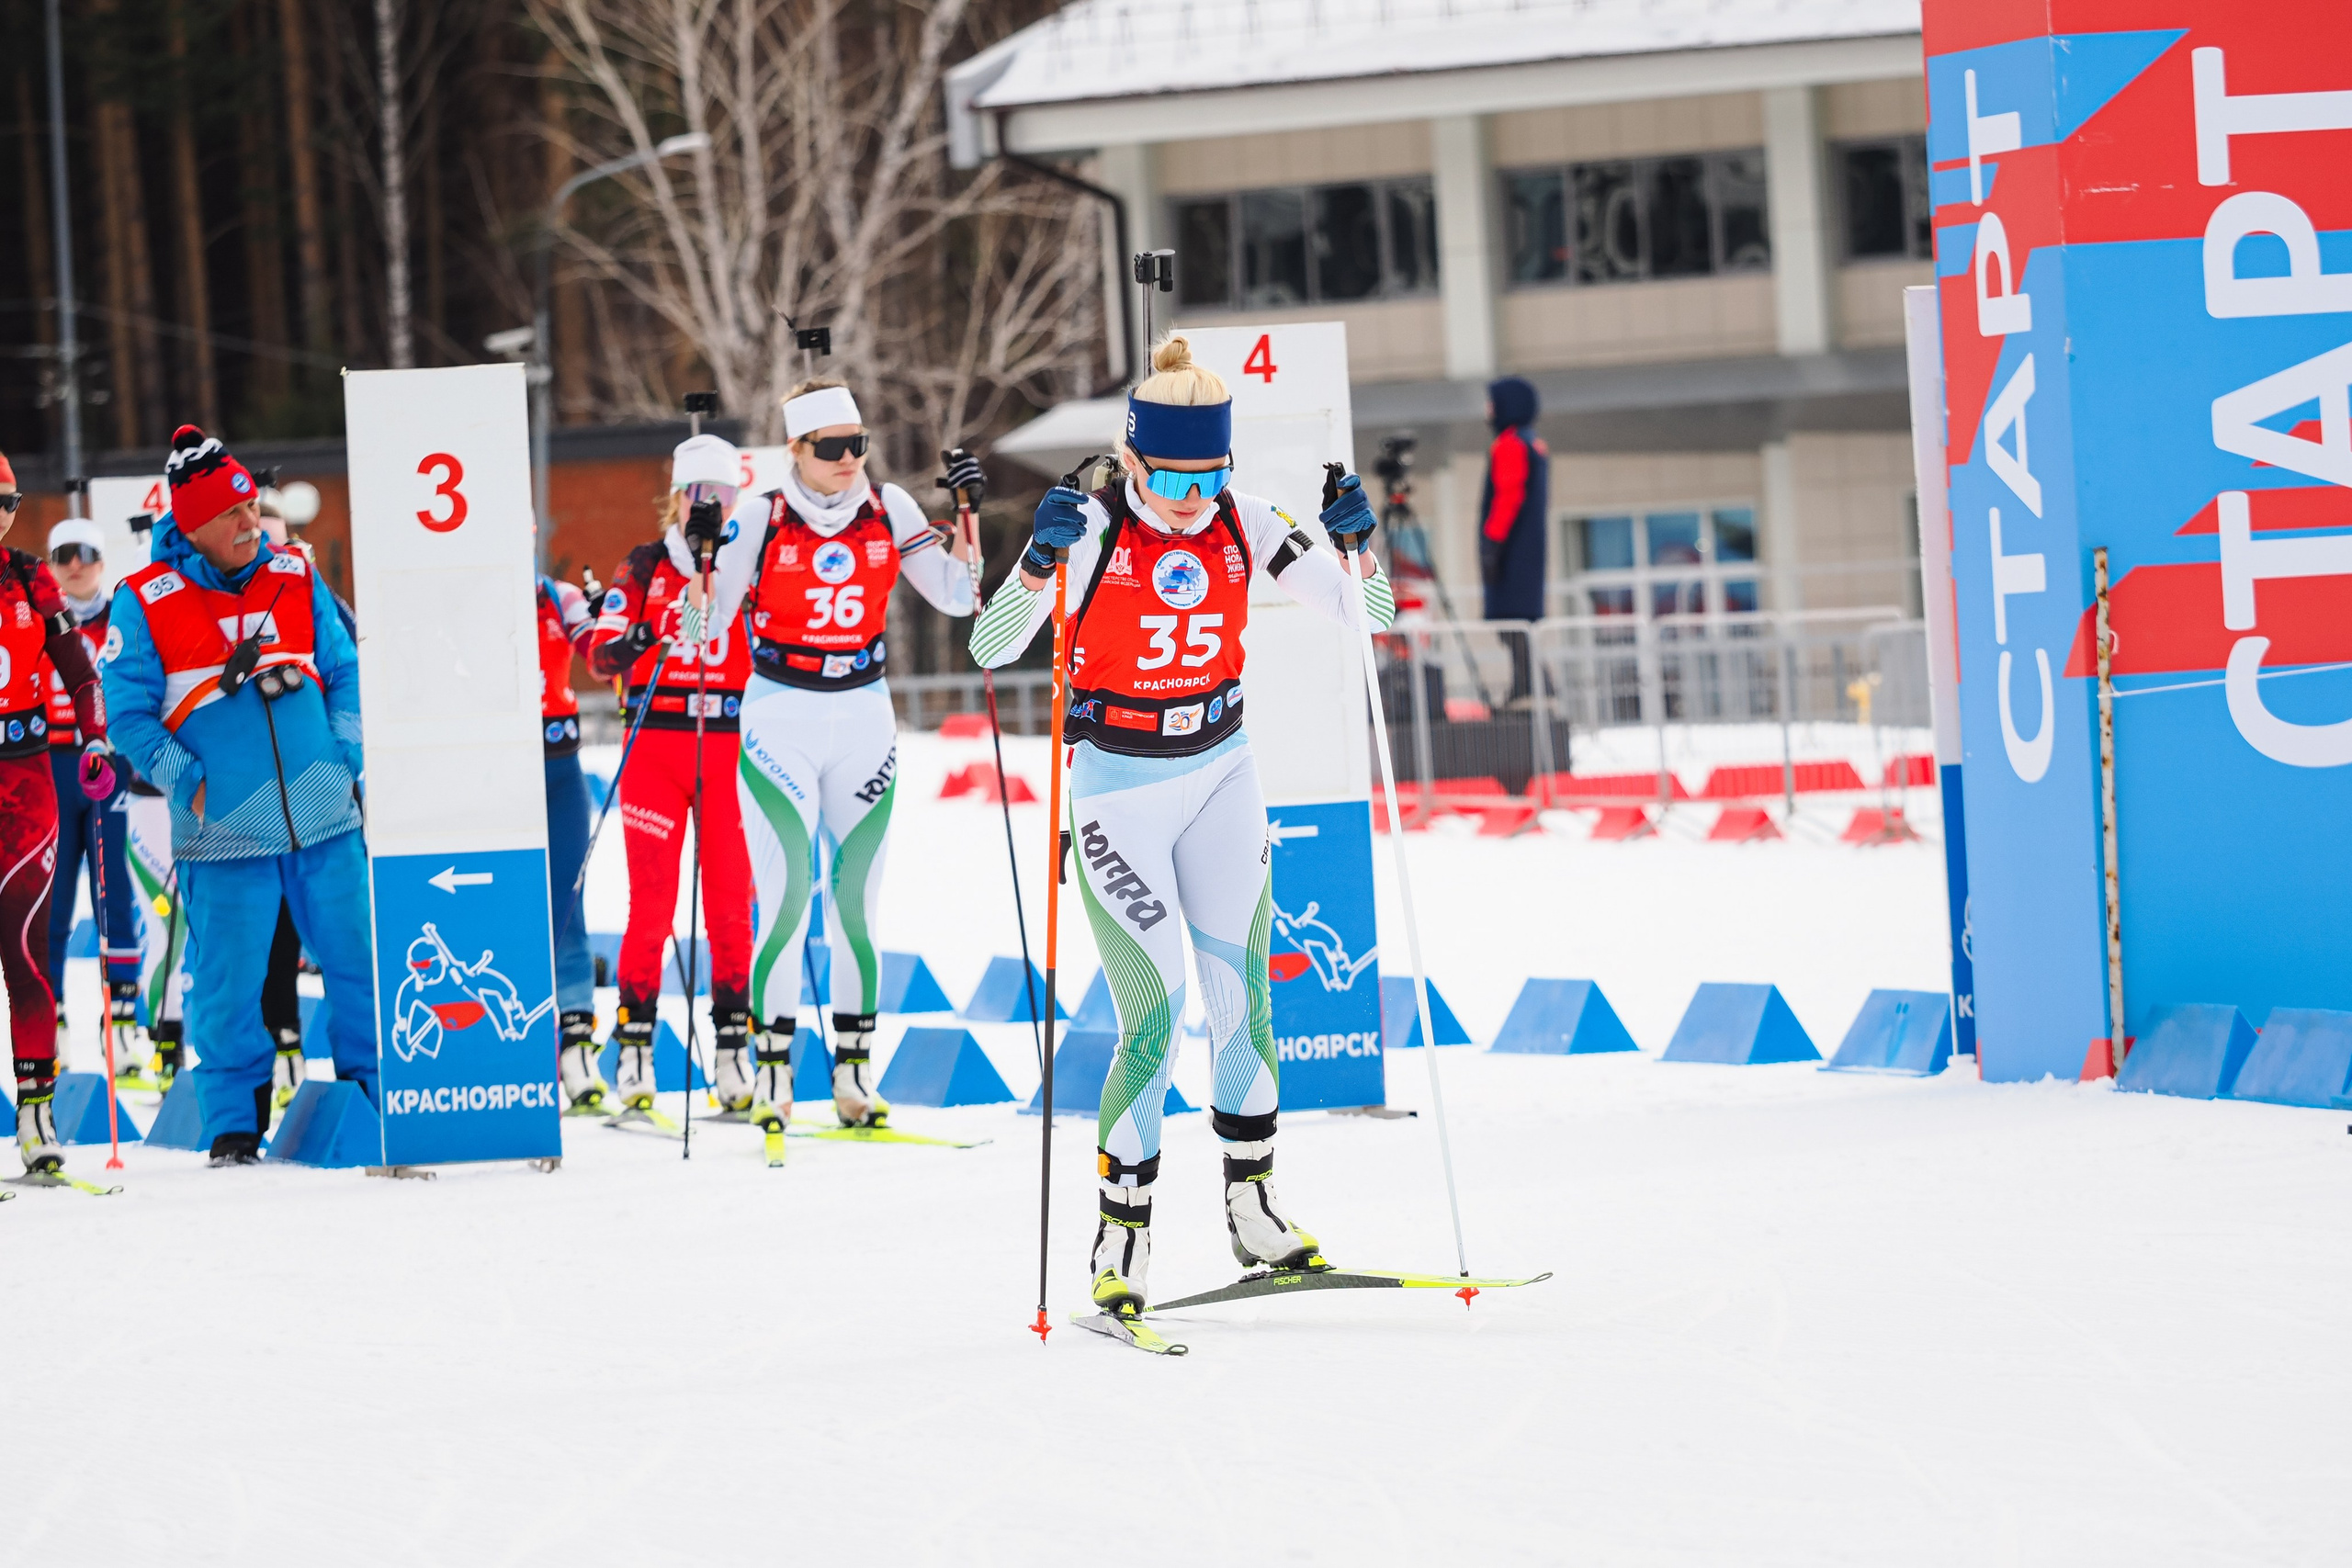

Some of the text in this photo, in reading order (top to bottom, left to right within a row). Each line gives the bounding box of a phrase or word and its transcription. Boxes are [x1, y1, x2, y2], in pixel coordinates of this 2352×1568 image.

[1243, 333, 1277, 383] 4
[2191, 46, 2352, 768] СТАРТ
[1963, 69, 2054, 784] СТАРТ
[141, 481, 165, 515] 4
[415, 452, 468, 533] 3
[1223, 545, 1239, 555] СПО
[1227, 563, 1245, 573] ЖИЗН
[149, 575, 175, 597] 35
[805, 584, 865, 629] 36
[1136, 613, 1224, 671] 35
[668, 671, 726, 682] КРАСНЯРСК
[1133, 672, 1211, 691] КРАСНОЯРСК
[1275, 1032, 1380, 1062] НОЯРСК
[386, 1082, 556, 1115] КРАСНОЯРСК
[1273, 1275, 1302, 1286] FISCHER
